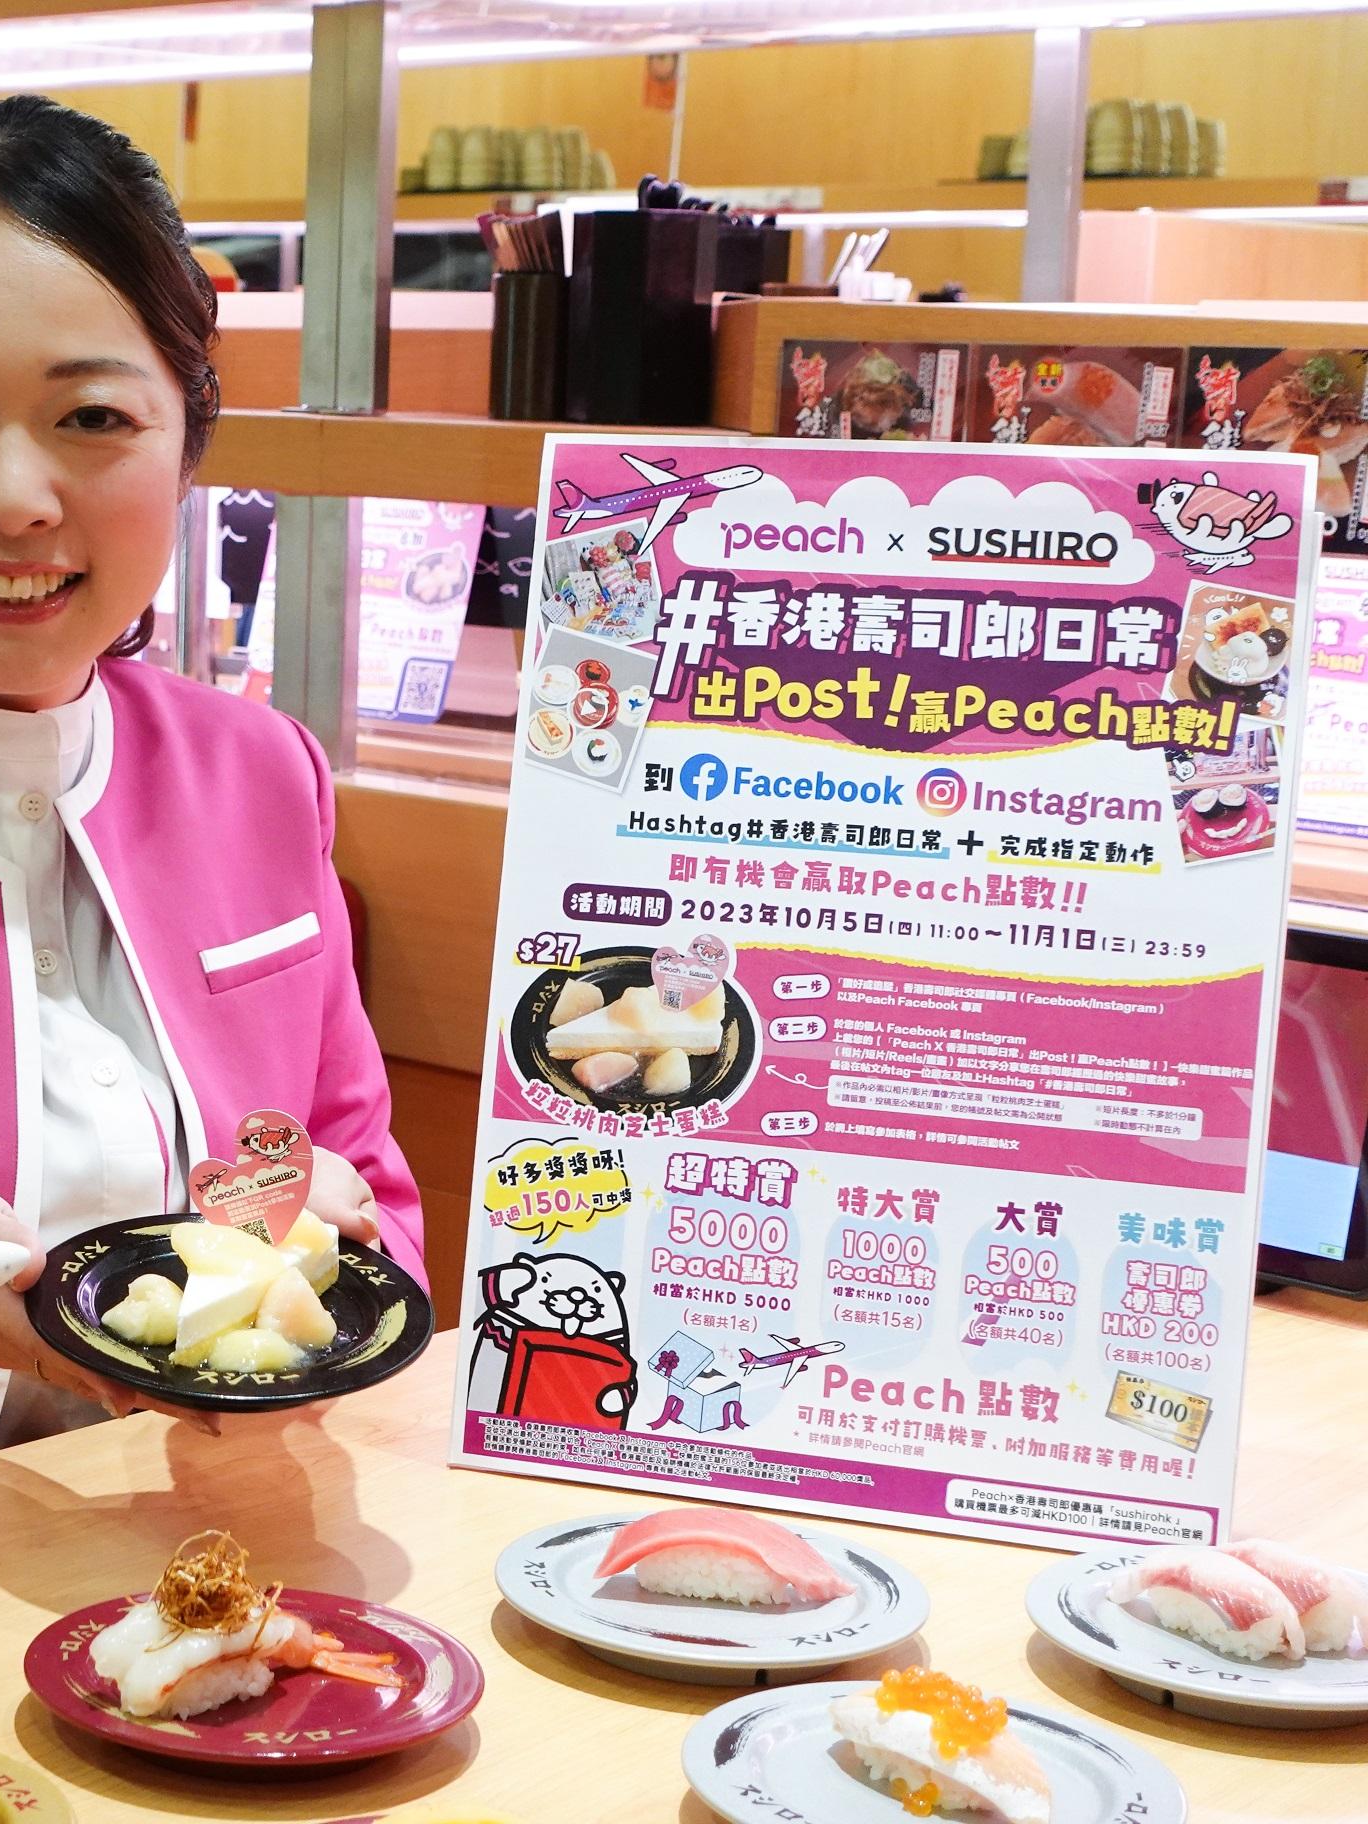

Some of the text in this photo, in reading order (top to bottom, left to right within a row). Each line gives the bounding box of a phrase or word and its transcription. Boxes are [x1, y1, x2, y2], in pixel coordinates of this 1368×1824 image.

[720, 517, 863, 558] peach
[930, 526, 1119, 563] SUSHIRO
[651, 578, 1163, 696] #香港壽司郎日常
[643, 763, 1163, 825] 到 Facebook Instagram
[1000, 835, 1154, 865] 完成指定動作
[569, 891, 667, 921] 活動期間
[1144, 940, 1206, 958] 23:59
[518, 932, 581, 965] $27
[781, 980, 822, 994] 第一步
[897, 996, 959, 1011] Facebook
[776, 1021, 819, 1035] 第二步
[886, 1023, 948, 1039] Facebook
[962, 1031, 1027, 1046] Instagram
[524, 1081, 726, 1137] 粒粒桃肉芝士蛋糕
[768, 1116, 811, 1131] 第三步
[208, 1186, 246, 1205] peach
[256, 1169, 299, 1188] SUSHIRO
[664, 1152, 799, 1209] 超特賞
[489, 1187, 632, 1228] 超過150人可中獎
[836, 1187, 941, 1225] 特大賞
[995, 1201, 1064, 1238] 大賞
[668, 1206, 789, 1254] 5000
[842, 1228, 927, 1267] 1000
[1118, 1211, 1225, 1255] 美味賞
[59, 1240, 112, 1284] スシロー
[652, 1247, 799, 1290] Peach點數
[827, 1261, 936, 1292] Peach點數
[987, 1244, 1059, 1281] 500
[1127, 1260, 1207, 1292] 壽司郎
[652, 1283, 791, 1312] 相當於HKD 5000
[832, 1286, 930, 1307] 相當於HKD 1000
[964, 1274, 1076, 1307] Peach點數
[973, 1302, 1065, 1322] 相當於HKD 500
[1101, 1312, 1219, 1347] HKD 200
[193, 1370, 302, 1386] スシロー
[822, 1364, 1062, 1425] Peach 點數
[1130, 1389, 1189, 1423] $100
[523, 1558, 556, 1599] スシロー
[61, 1618, 109, 1662] スシロー
[789, 1622, 872, 1649] スシロー
[1161, 1657, 1272, 1685] スシロー
[243, 1728, 358, 1746] スシロー
